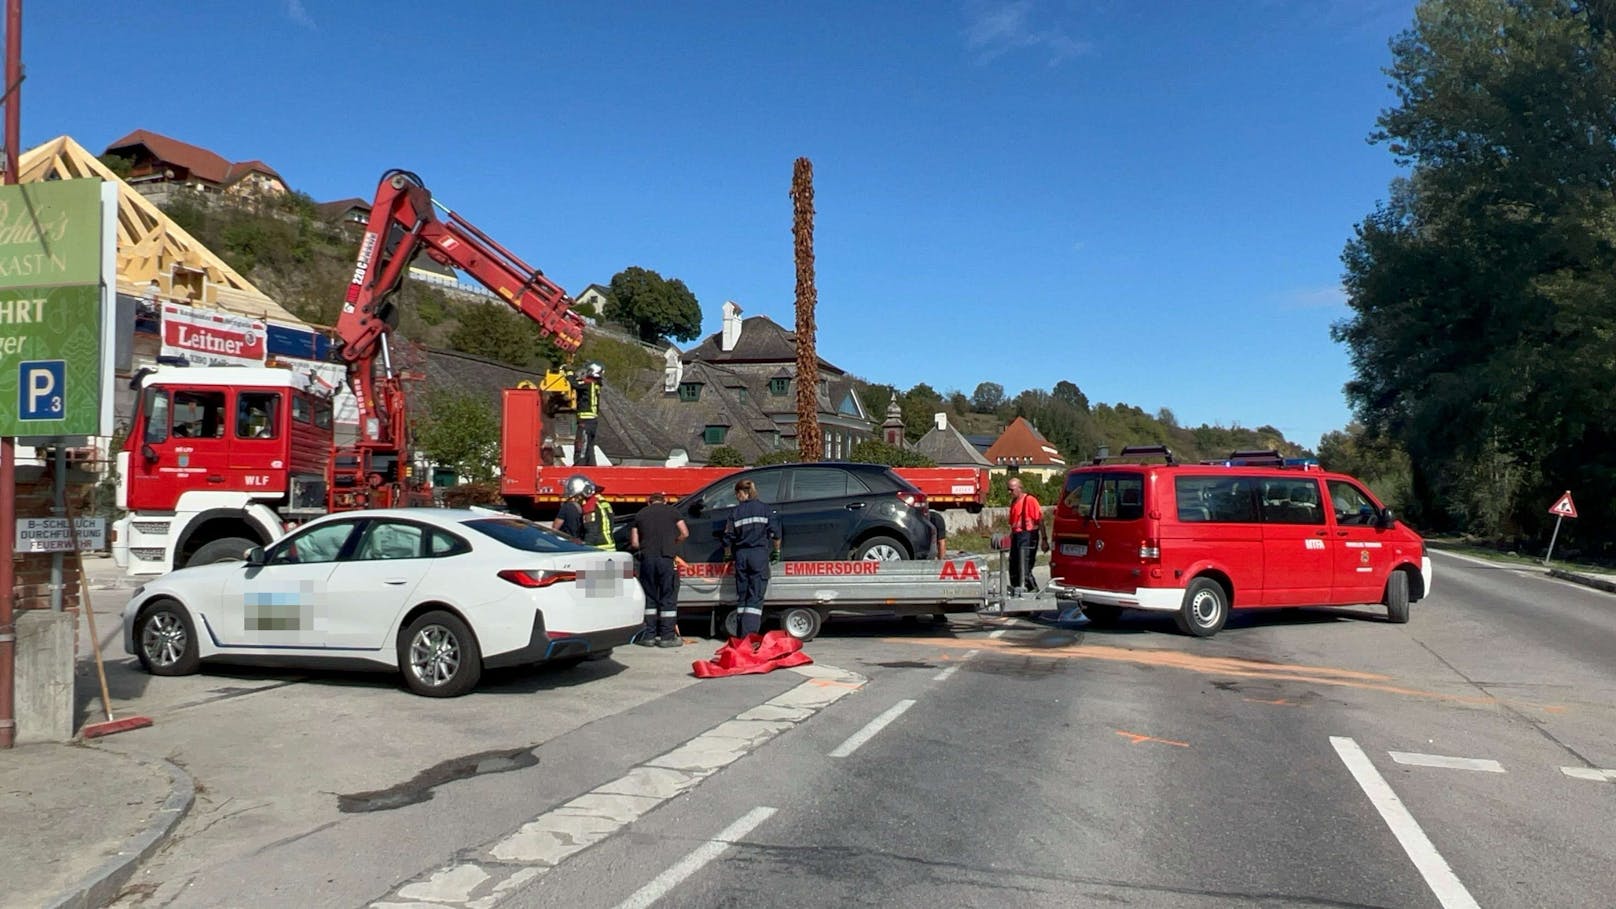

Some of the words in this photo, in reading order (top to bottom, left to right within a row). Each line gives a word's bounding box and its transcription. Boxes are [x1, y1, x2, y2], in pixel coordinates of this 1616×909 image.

[178, 325, 244, 355] Leitner
[29, 368, 55, 413] P
[51, 396, 61, 412] 3
[244, 475, 270, 486] WLF
[28, 520, 96, 529] B-SCHLUCH
[30, 539, 92, 549] FEUERWHR
[784, 561, 881, 576] EMMERSDORF
[940, 560, 980, 580] AA
